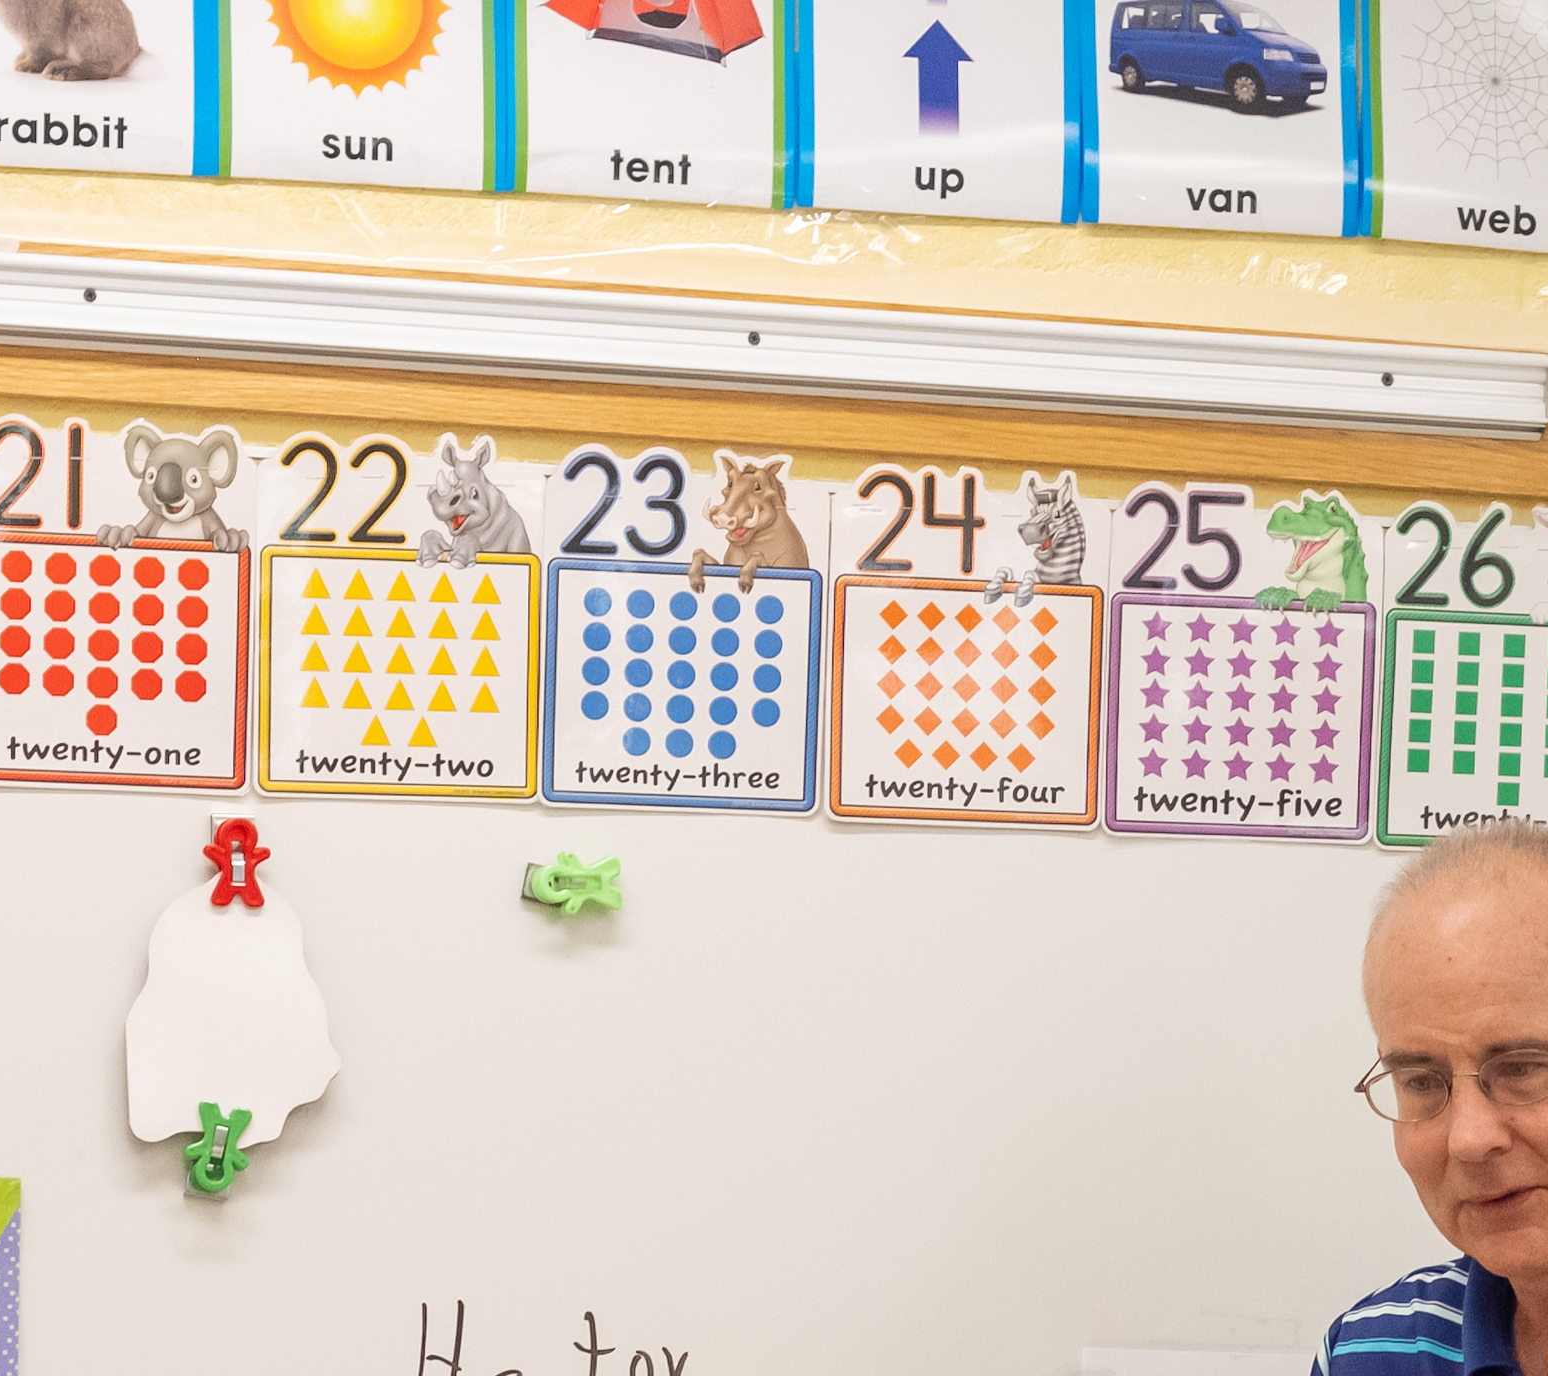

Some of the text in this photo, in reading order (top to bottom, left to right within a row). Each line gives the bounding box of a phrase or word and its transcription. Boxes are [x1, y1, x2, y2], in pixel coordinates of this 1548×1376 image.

[321, 133, 394, 163] sun
[609, 152, 692, 186] tent
[915, 166, 965, 200] up
[1185, 187, 1258, 215] van
[1456, 204, 1538, 237] web
[282, 441, 407, 545] 22
[561, 455, 686, 557] 23
[861, 473, 985, 574] 24
[1123, 492, 1246, 592] 25
[1395, 509, 1515, 609] 26
[6, 736, 202, 770] twenty-one
[298, 747, 495, 783] twenty-two
[574, 760, 781, 792] twenty-three
[864, 773, 1066, 808] twenty-four
[1132, 785, 1343, 821] twenty-five
